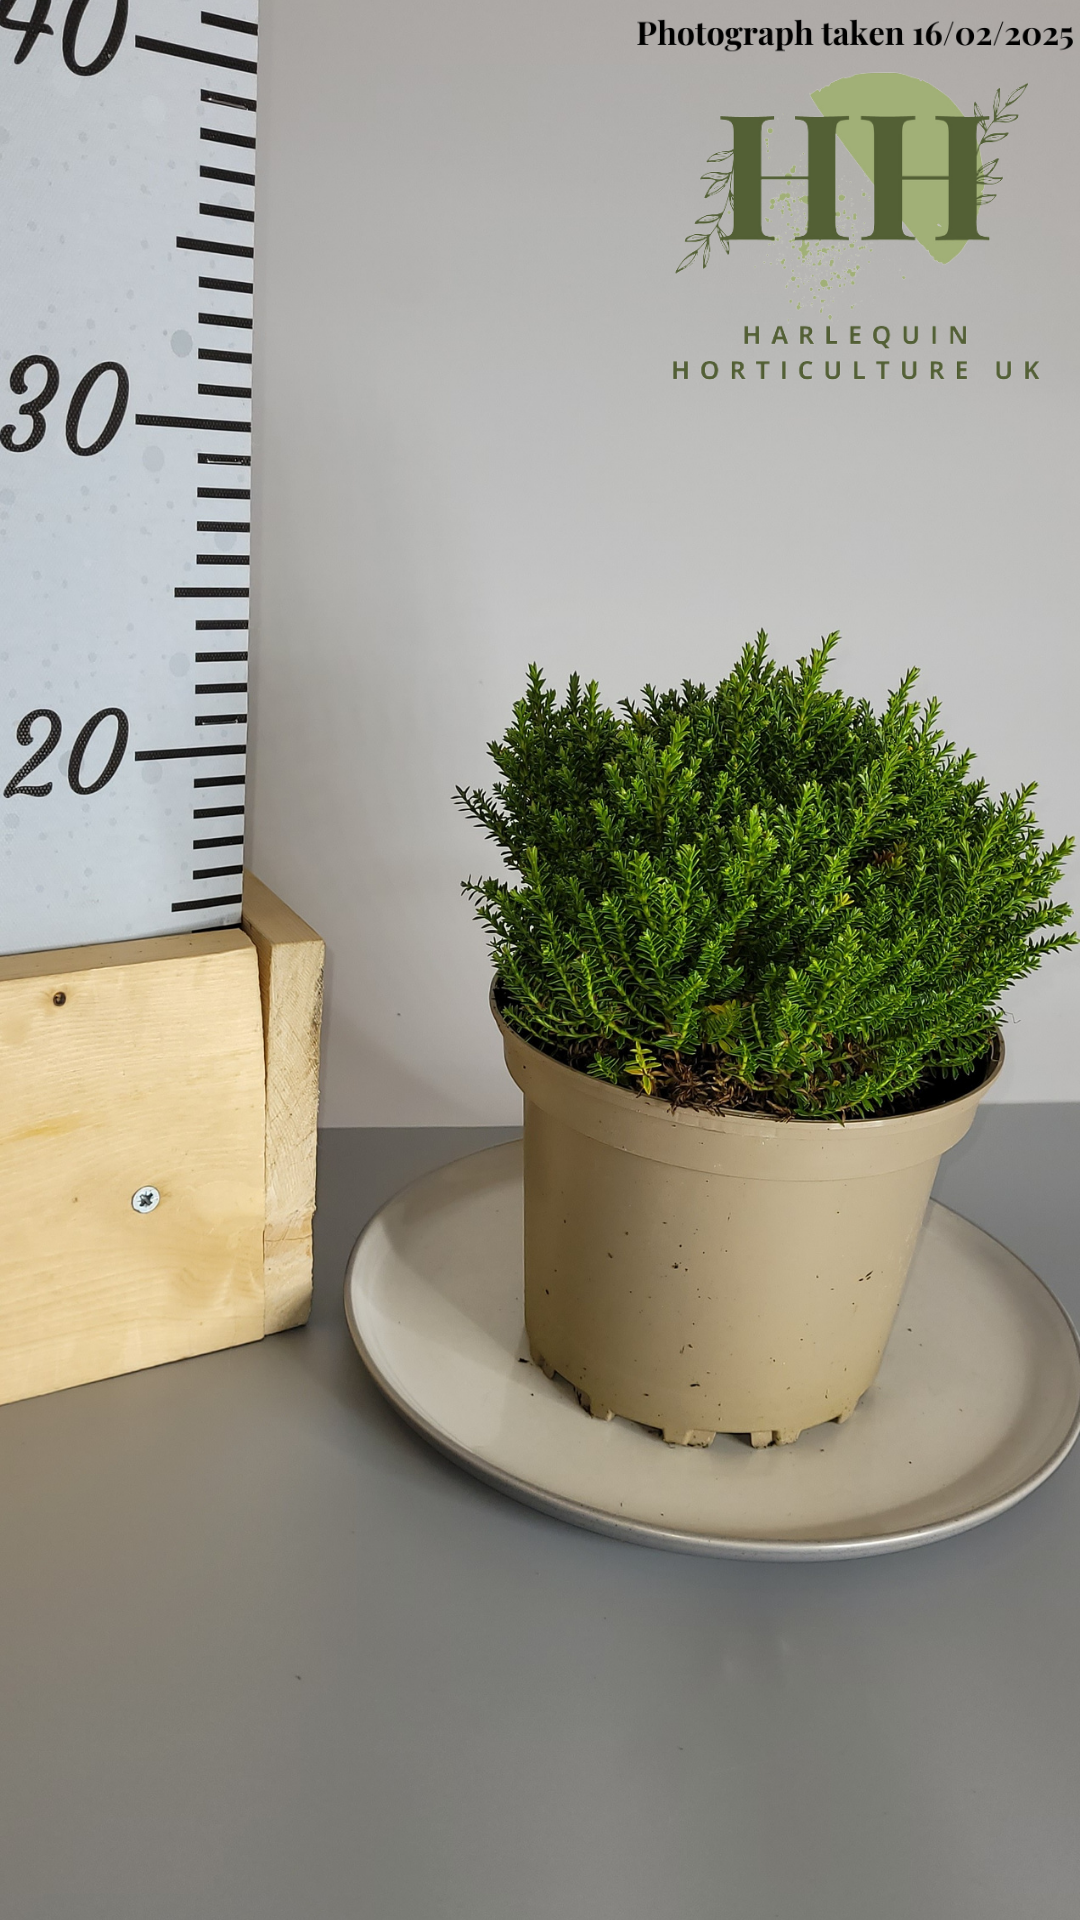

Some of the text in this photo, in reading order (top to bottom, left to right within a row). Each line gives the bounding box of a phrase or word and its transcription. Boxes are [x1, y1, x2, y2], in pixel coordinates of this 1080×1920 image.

[0, 0, 129, 77] 40
[0, 354, 130, 457] 30
[3, 707, 129, 799] 20
